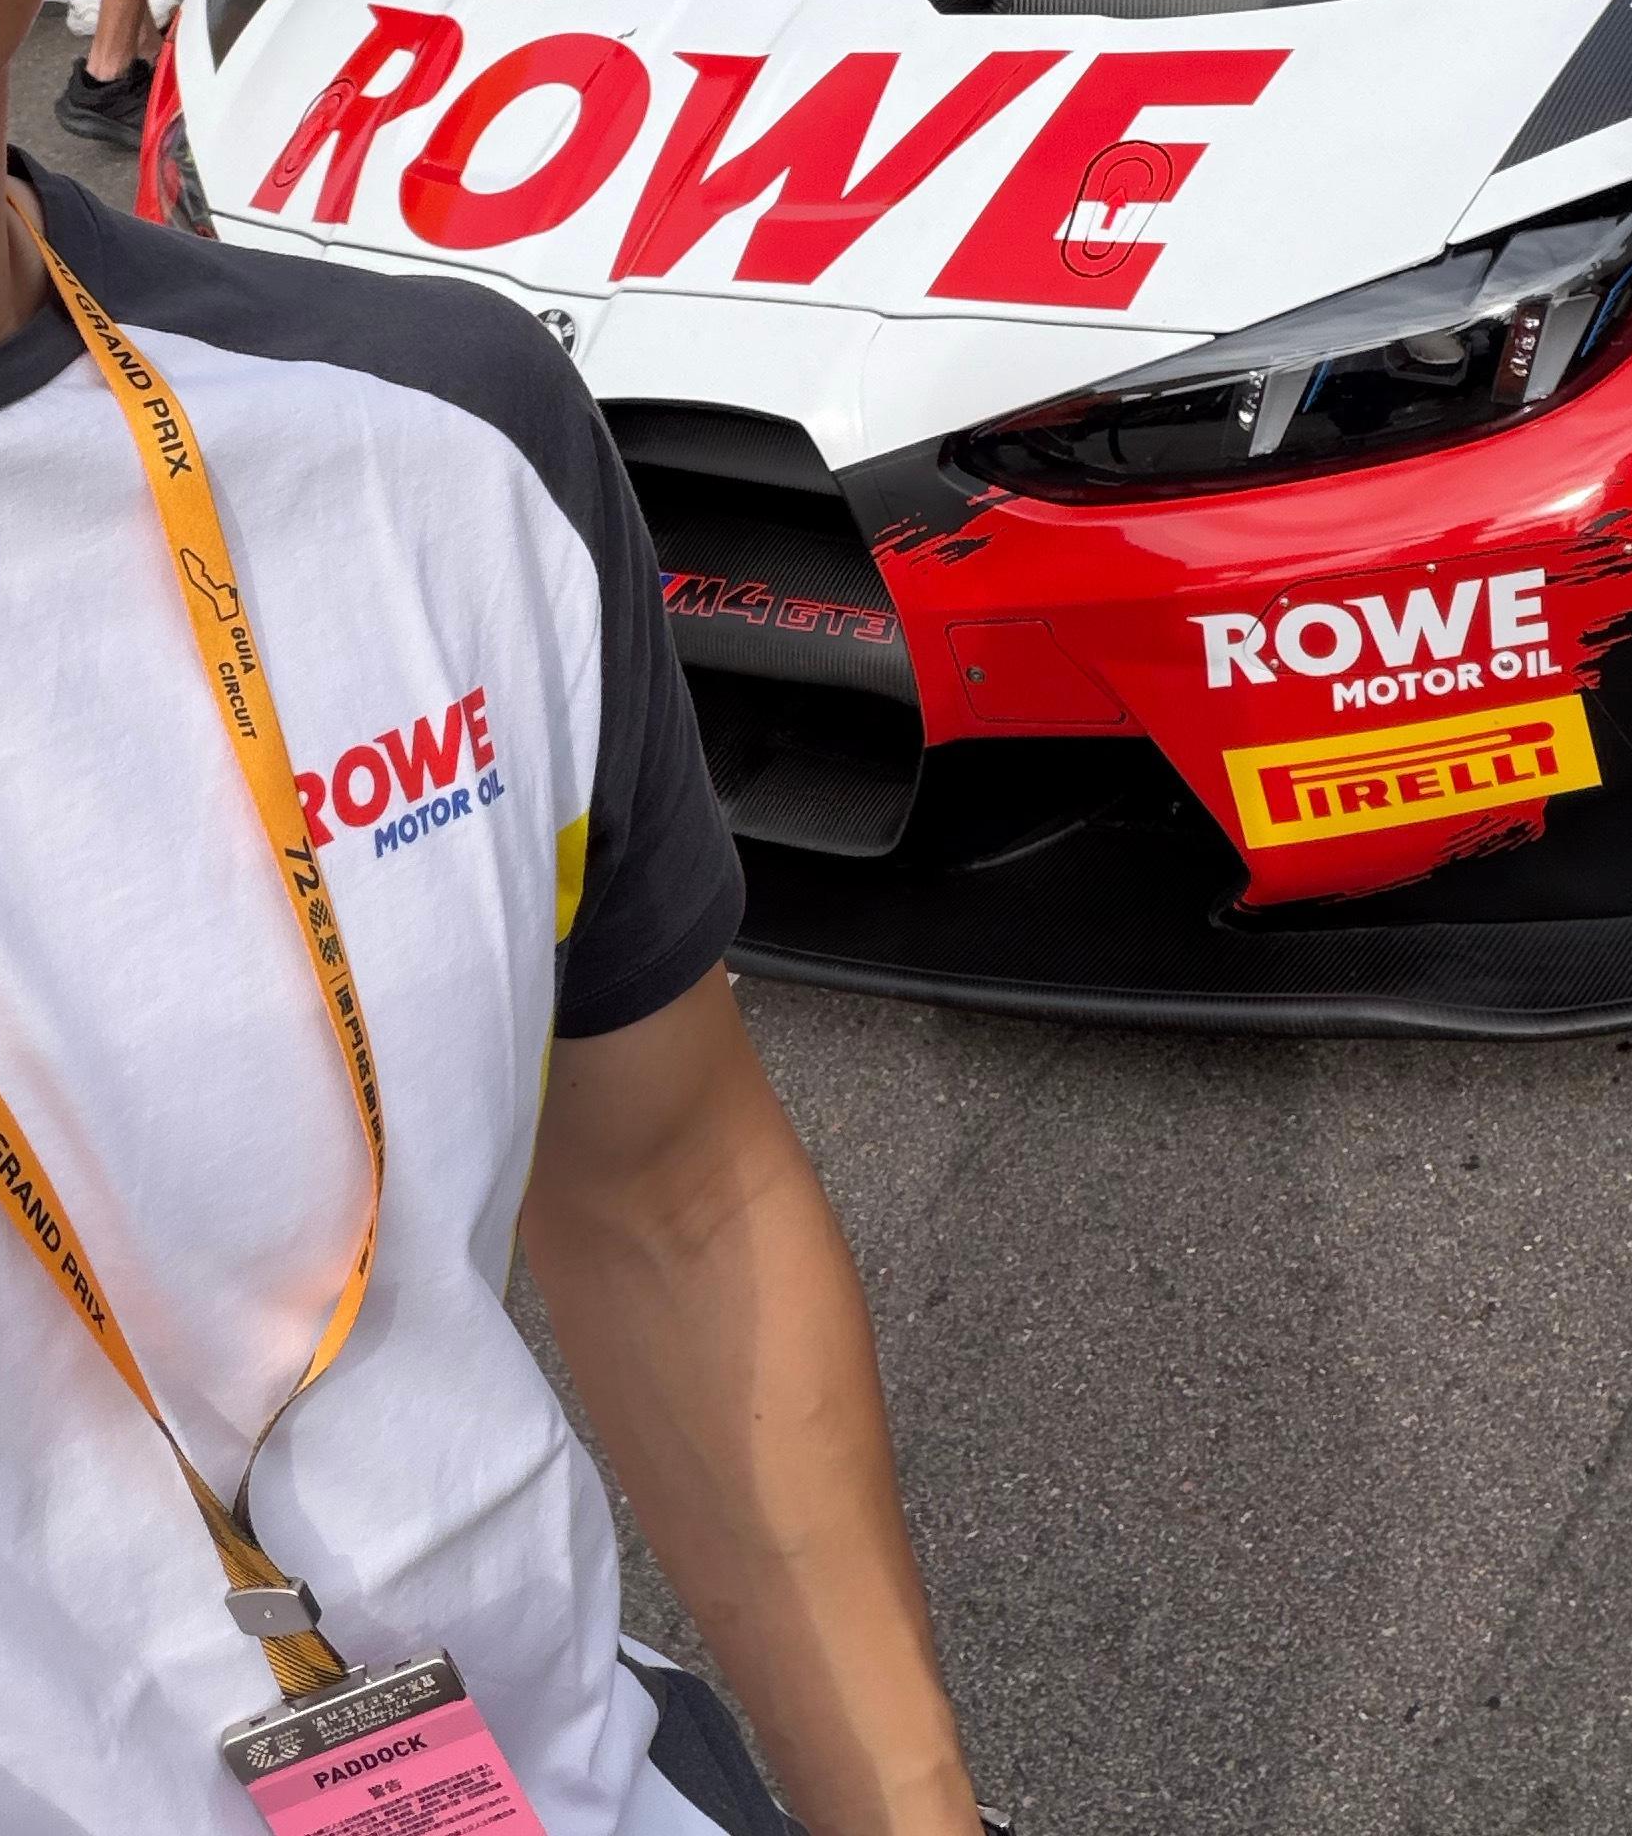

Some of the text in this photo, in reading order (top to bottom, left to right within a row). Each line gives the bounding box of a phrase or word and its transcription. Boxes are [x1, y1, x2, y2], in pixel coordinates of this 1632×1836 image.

[250, 3, 1294, 310] ROWE
[75, 291, 193, 479] GRAND PRIX
[230, 626, 257, 676] GUIA
[664, 577, 898, 645] M4 GT3
[1186, 567, 1549, 689] ROWE
[217, 661, 257, 741] CIRCUIT
[1332, 649, 1563, 712] MOTOR OIL
[294, 685, 496, 849] ROWE
[1257, 721, 1559, 825] PIRELLI
[374, 768, 505, 859] MOTOR OIL
[284, 835, 321, 898] 72
[60, 1252, 106, 1334] PRIX
[313, 1733, 428, 1790] PADDOCK
